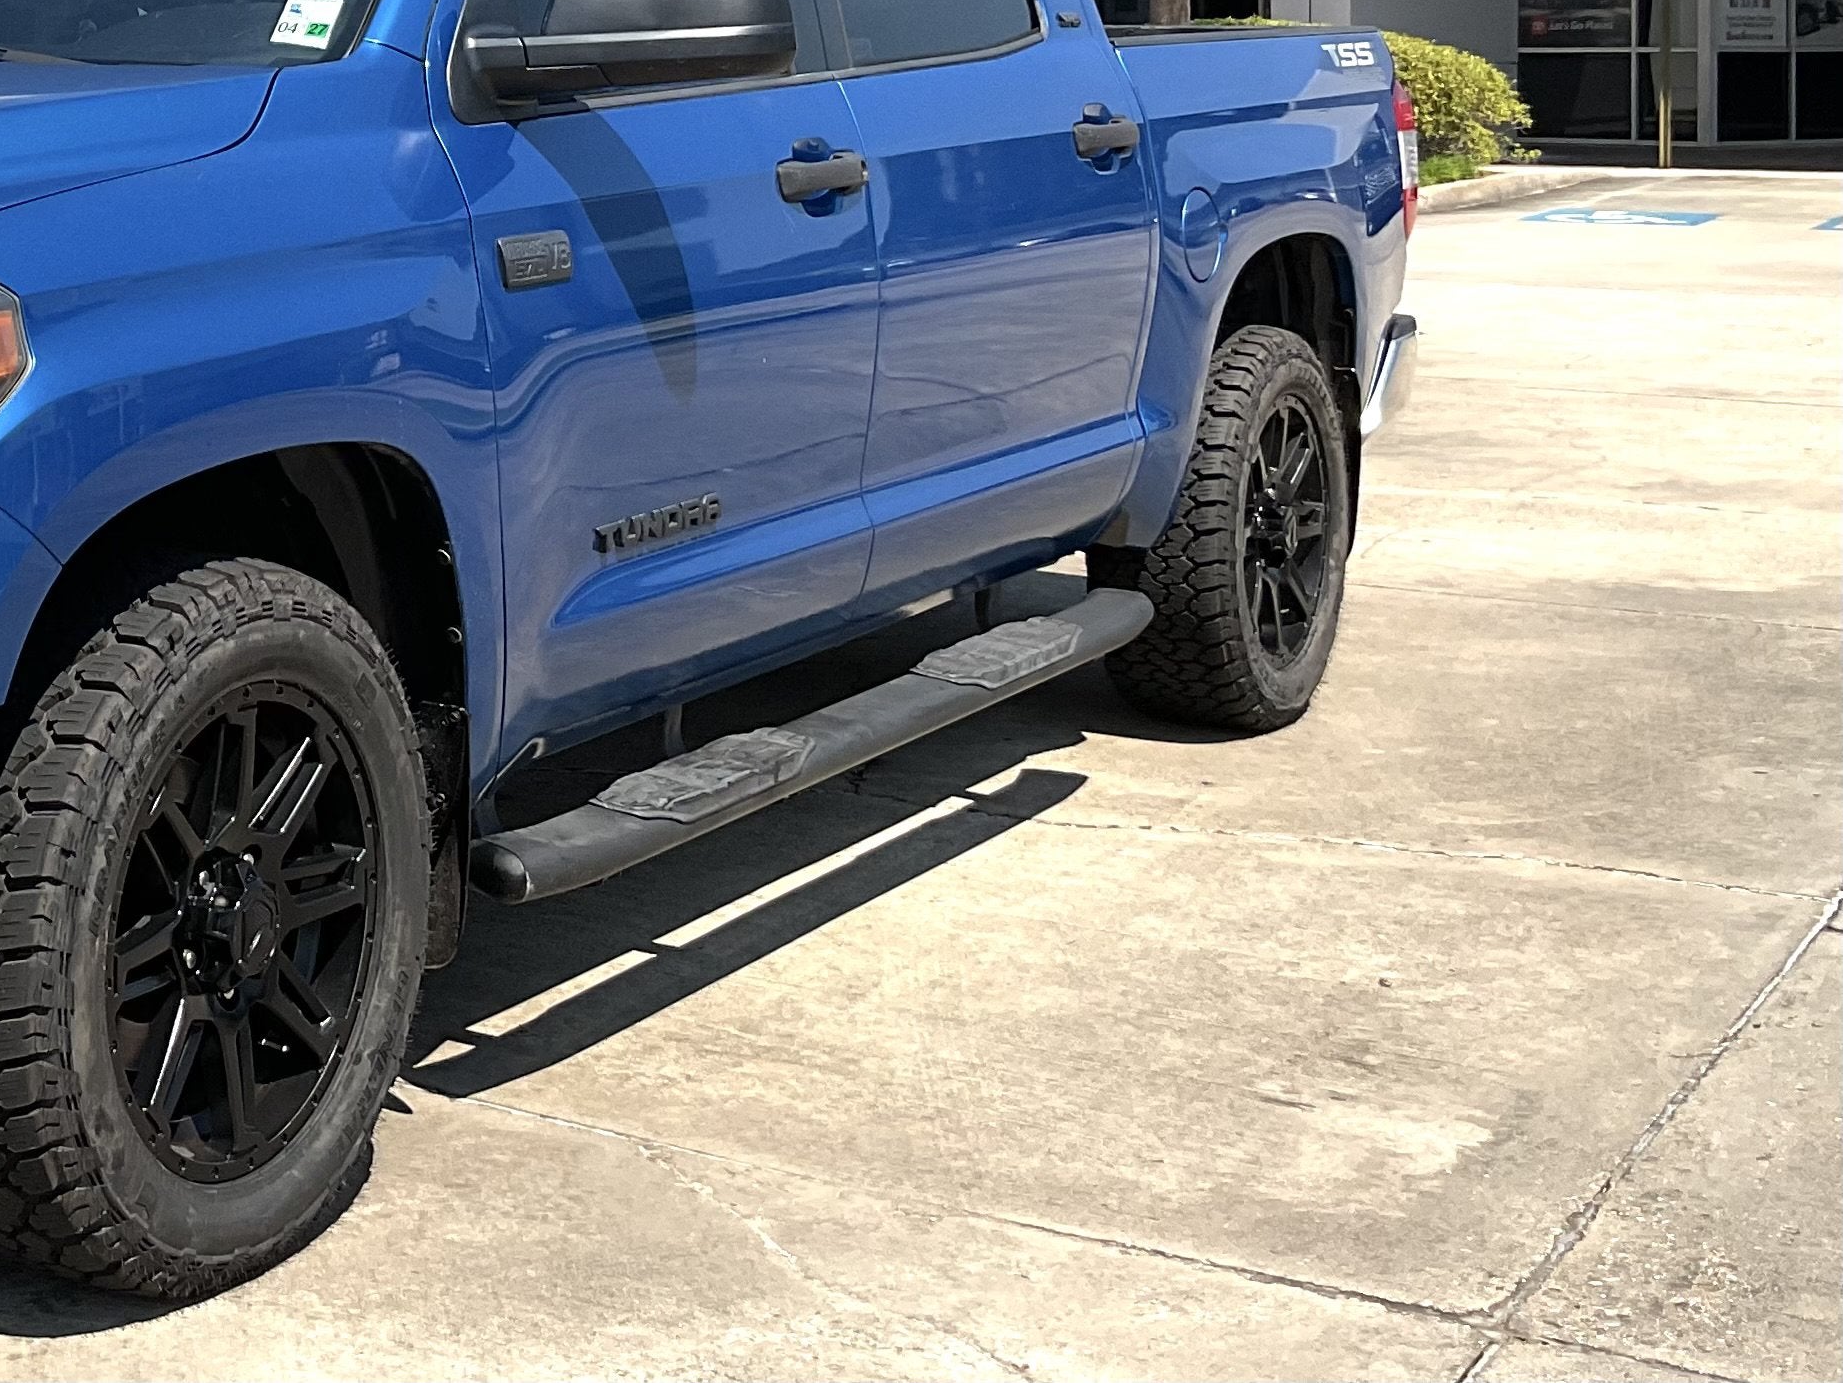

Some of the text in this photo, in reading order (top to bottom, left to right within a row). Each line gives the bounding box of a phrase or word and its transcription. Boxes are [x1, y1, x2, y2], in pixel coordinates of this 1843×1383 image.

[278, 21, 330, 36] 04 27
[1320, 41, 1375, 68] TSS
[592, 492, 723, 554] TUNDRA
